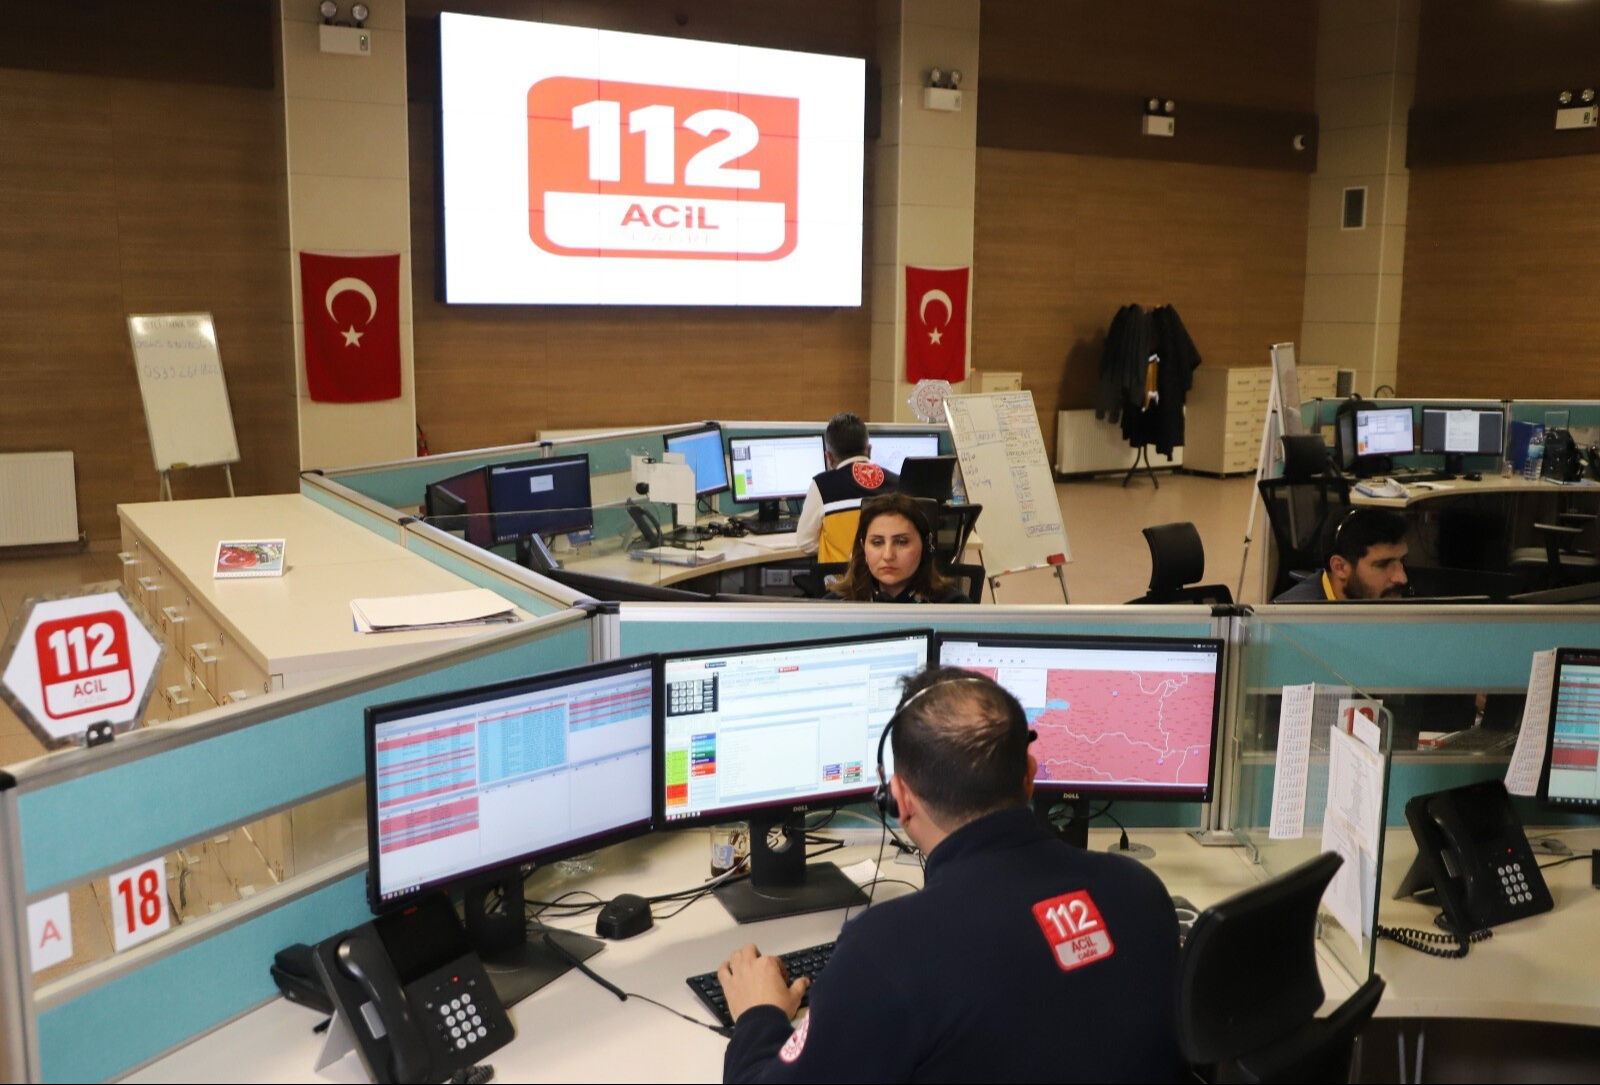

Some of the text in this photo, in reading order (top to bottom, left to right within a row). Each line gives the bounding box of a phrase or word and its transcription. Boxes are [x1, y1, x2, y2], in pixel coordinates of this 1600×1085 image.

[571, 99, 761, 190] 112
[47, 621, 119, 677] 112
[117, 869, 161, 933] 18
[1045, 898, 1098, 939] 112
[39, 917, 62, 949] A
